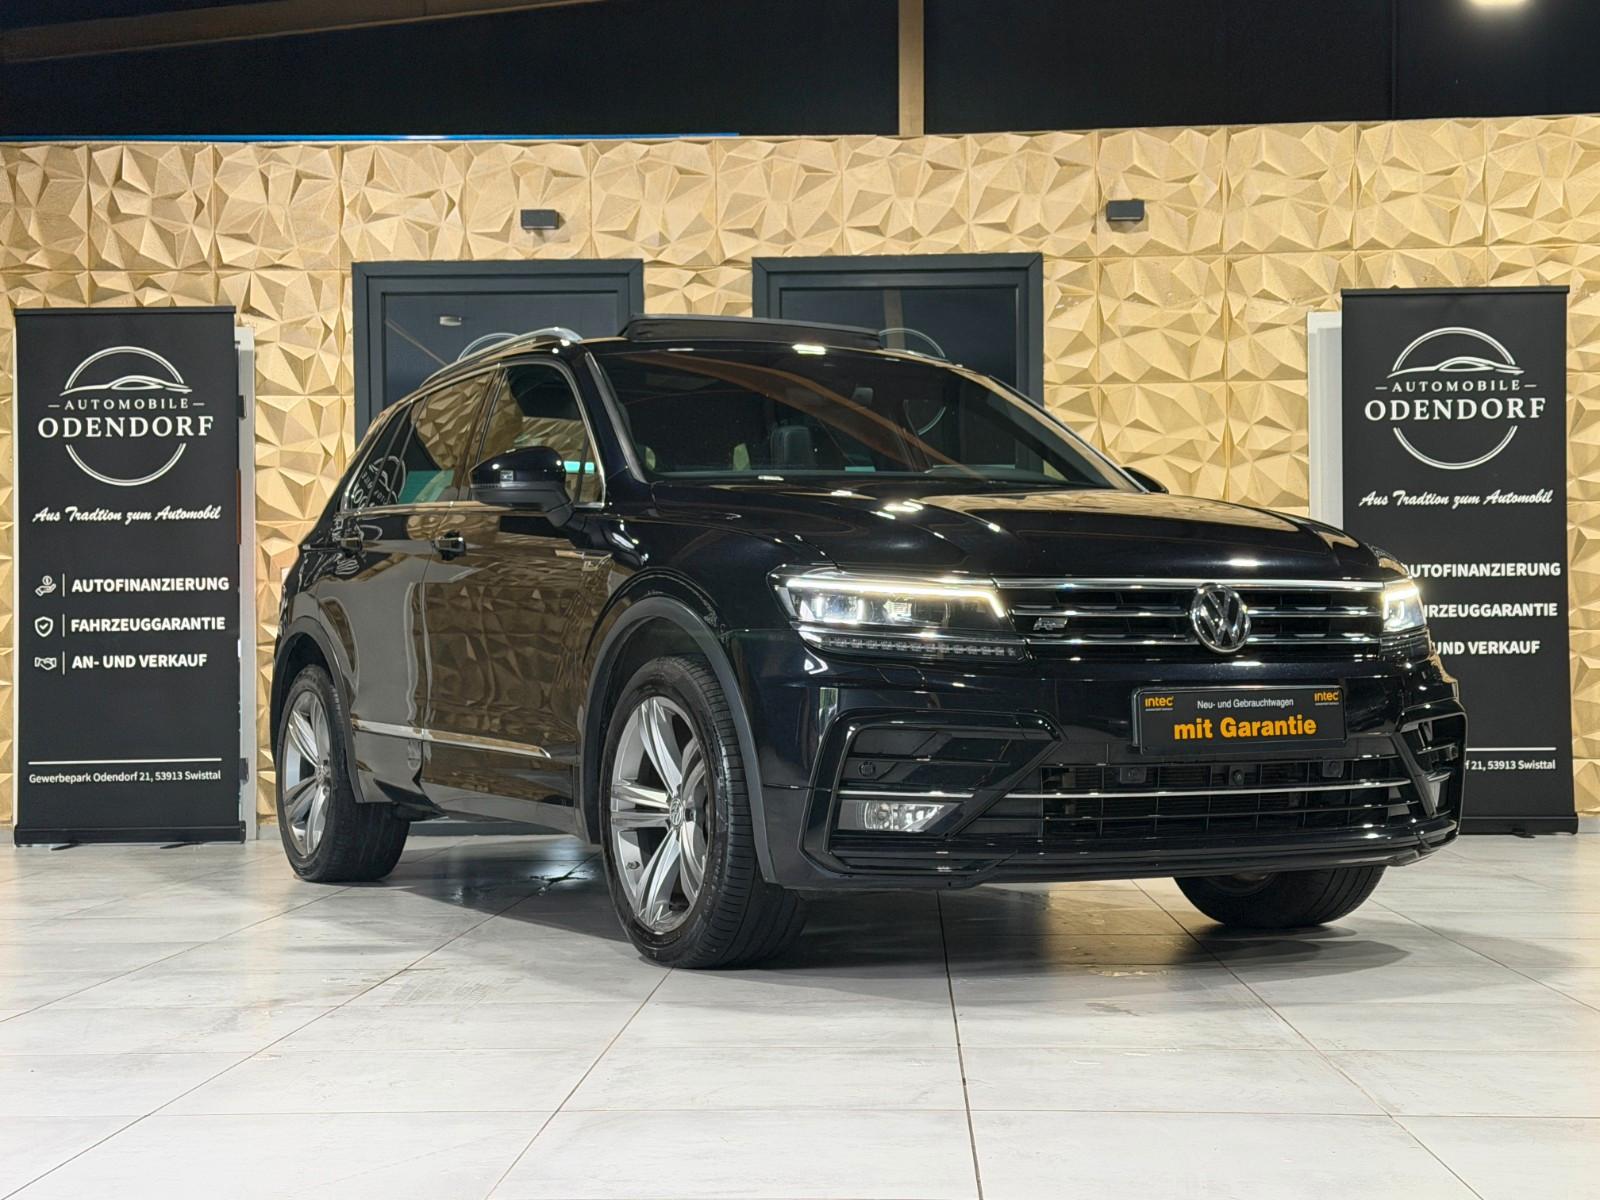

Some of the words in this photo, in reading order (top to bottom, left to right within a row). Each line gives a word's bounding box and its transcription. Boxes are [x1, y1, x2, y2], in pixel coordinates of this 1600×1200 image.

[1391, 379, 1520, 393] AUTOMOBILE
[64, 398, 188, 411] AUTOMOBILE
[1364, 397, 1546, 421] ODENDORF
[37, 415, 214, 438] ODENDORF
[1358, 490, 1389, 507] Aus
[1451, 496, 1480, 510] zum
[1483, 488, 1554, 505] Automobil
[32, 506, 61, 522] Aus
[124, 511, 152, 526] zum
[154, 505, 222, 521] Automobil
[1404, 562, 1561, 577] UTOFINANZIERUNG
[71, 577, 230, 593] AUTOFINANZIERUNG
[70, 616, 226, 633] FAHRZEUGGARANTIE
[1467, 640, 1541, 655] VERKAUF
[71, 655, 99, 669] AN-
[102, 654, 136, 669] UND
[138, 653, 208, 668] VERKAUF
[1145, 696, 1174, 707] intec
[1197, 700, 1216, 709] Neu-
[1217, 699, 1231, 709] und
[1233, 698, 1294, 710] Gebrauchtwagen
[1314, 691, 1339, 702] intec
[1174, 718, 1213, 740] mit
[1219, 714, 1317, 738] Garantie
[1471, 760, 1486, 771] 21,
[1487, 760, 1516, 770] 53913
[1518, 759, 1556, 770] Swisttal
[28, 773, 91, 785] Gewerbepark
[93, 771, 138, 783] Odendorf
[139, 772, 154, 783] 21,
[155, 771, 183, 781] 53913
[184, 770, 222, 781] Swisttal
